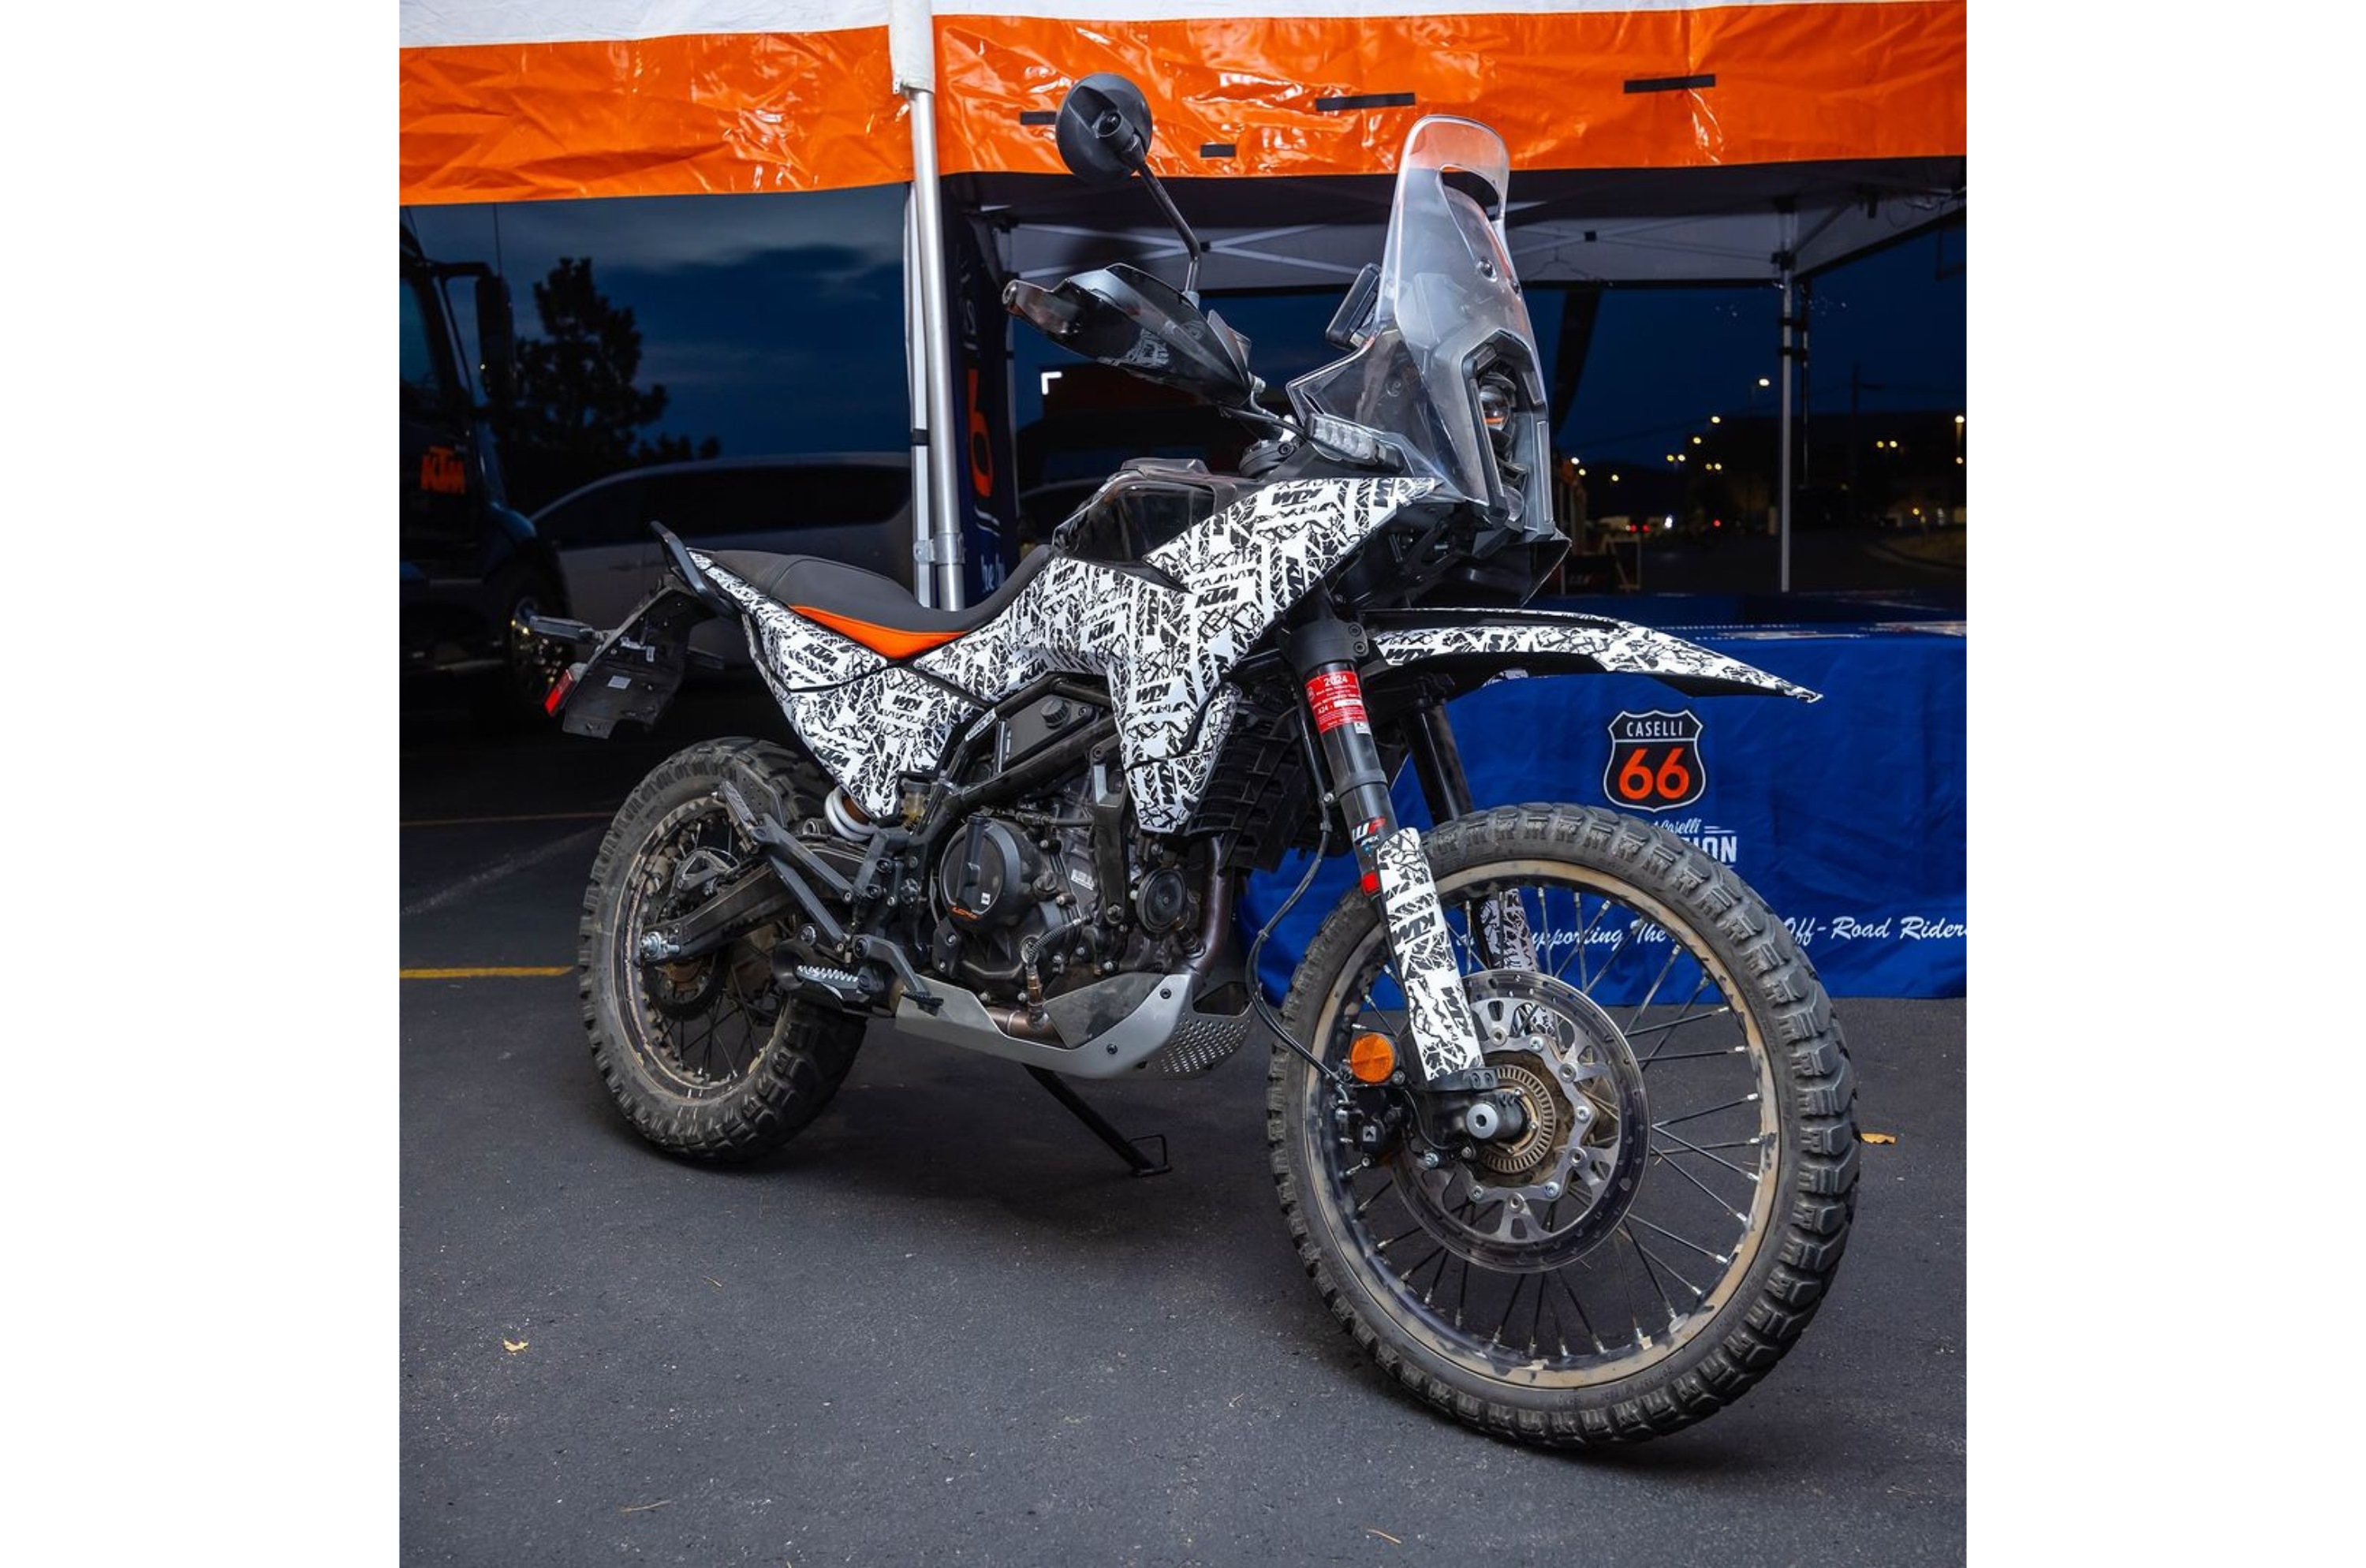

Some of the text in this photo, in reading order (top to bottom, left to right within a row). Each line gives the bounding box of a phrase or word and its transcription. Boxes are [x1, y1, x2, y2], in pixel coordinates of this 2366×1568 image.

[420, 446, 466, 495] KTM
[1195, 584, 1239, 609] KTM
[1088, 619, 1116, 644] KTM
[802, 643, 838, 666] KTM
[1019, 658, 1048, 685] KTM
[1135, 682, 1171, 705] KTM
[1626, 720, 1683, 737] CASELLI
[1618, 748, 1689, 800] 66
